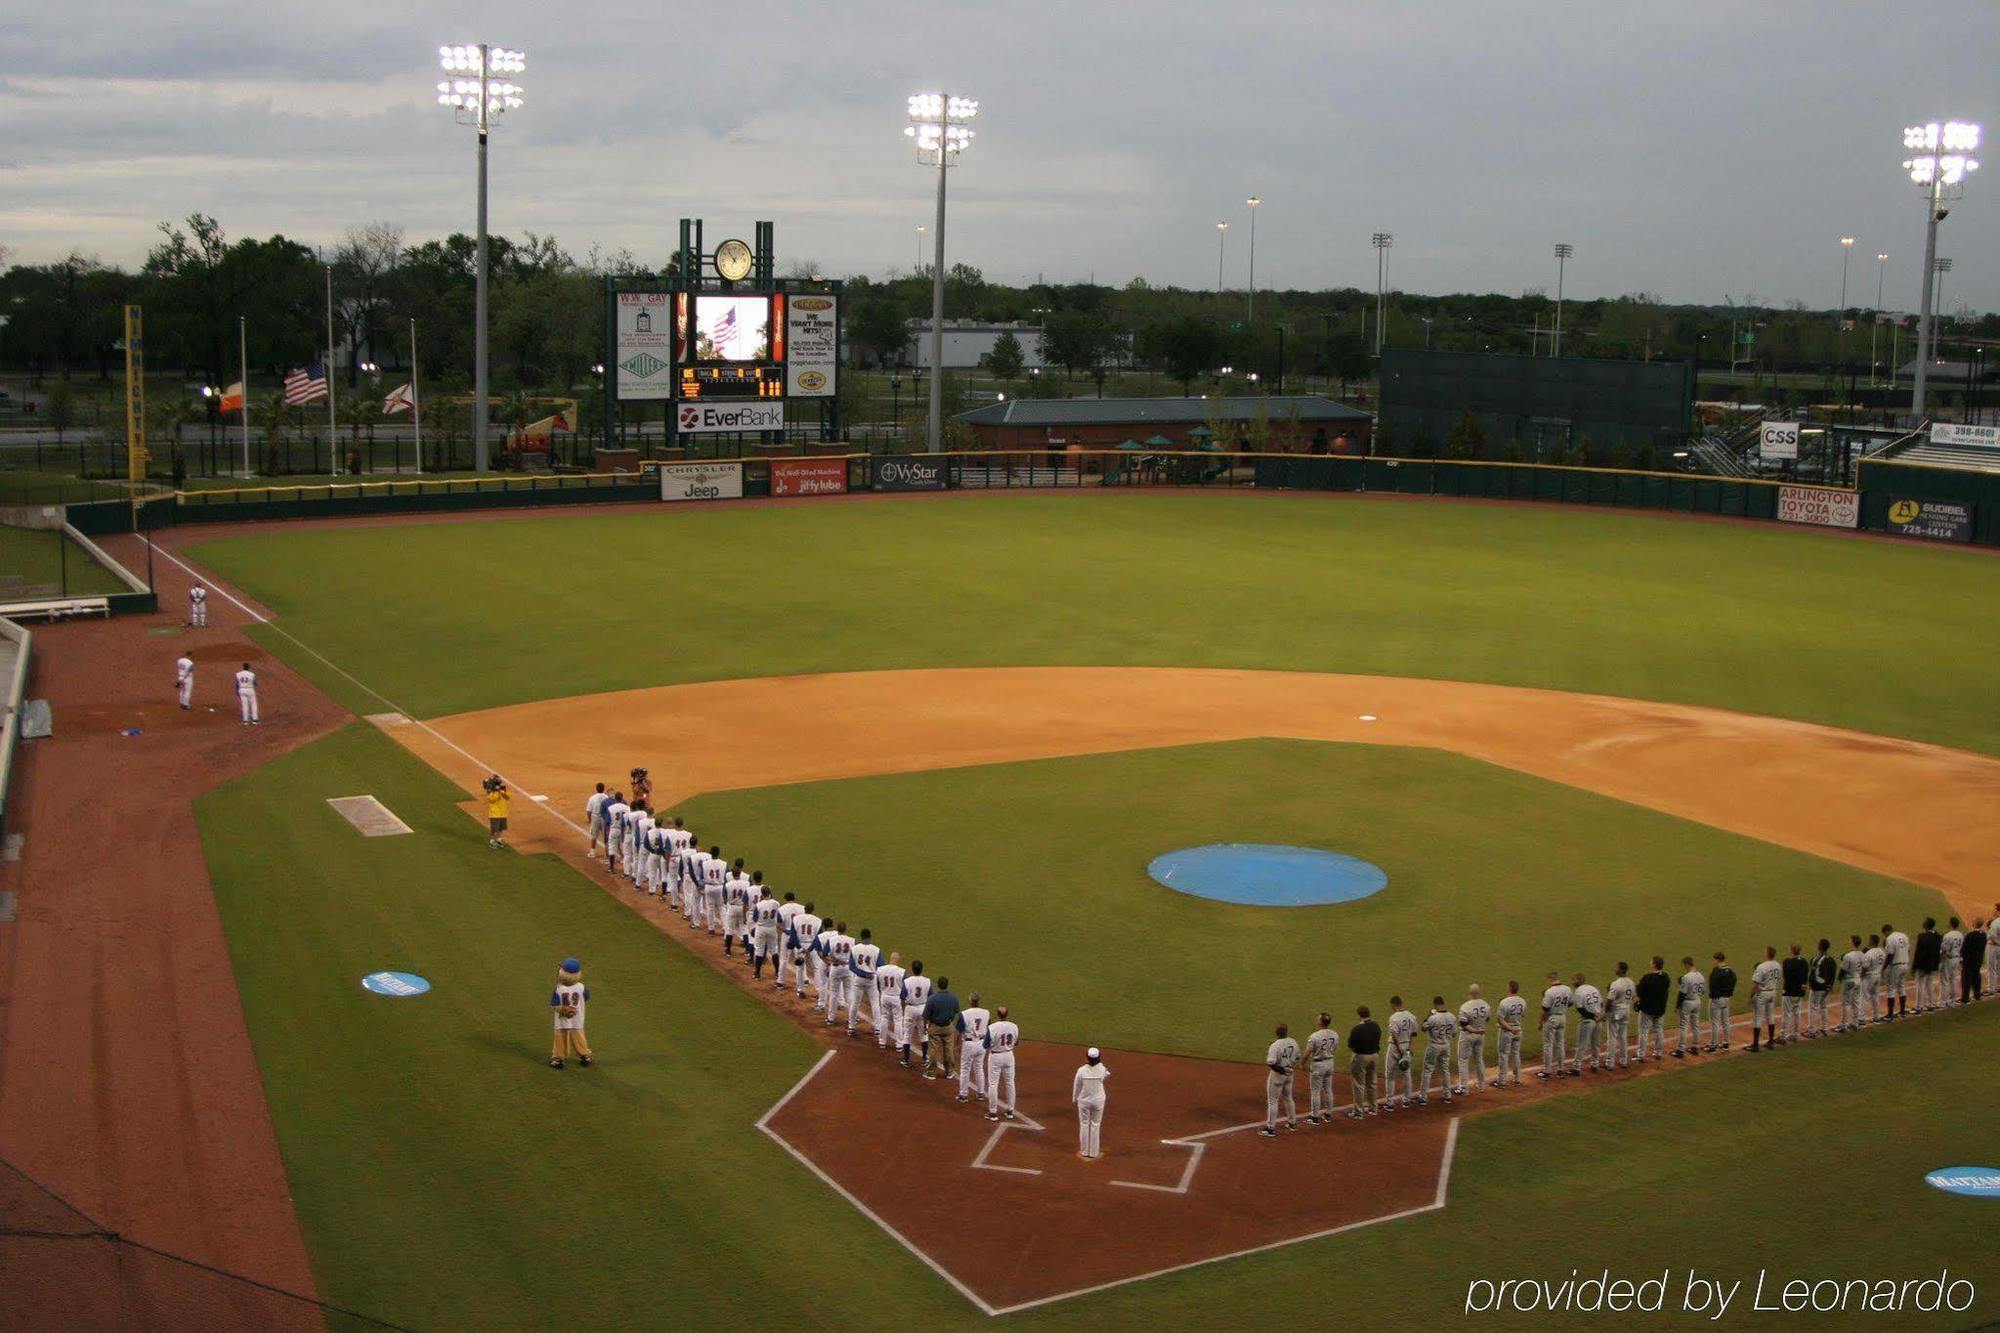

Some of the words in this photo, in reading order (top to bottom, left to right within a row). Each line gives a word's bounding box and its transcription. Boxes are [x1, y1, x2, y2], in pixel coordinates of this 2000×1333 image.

[647, 293, 667, 303] GAY
[703, 407, 781, 427] EverBank
[1763, 428, 1796, 446] CSS
[666, 465, 736, 475] CHRYSLER
[896, 463, 938, 483] VyStar
[684, 483, 720, 499] Jeep
[1780, 487, 1854, 506] ARLINGTON
[1781, 499, 1830, 514] TOYOTA
[1624, 988, 1632, 1001] 9
[1510, 1003, 1523, 1016] 23
[974, 1017, 982, 1031] 7
[1320, 1037, 1336, 1051] 27
[1281, 1045, 1295, 1059] 47
